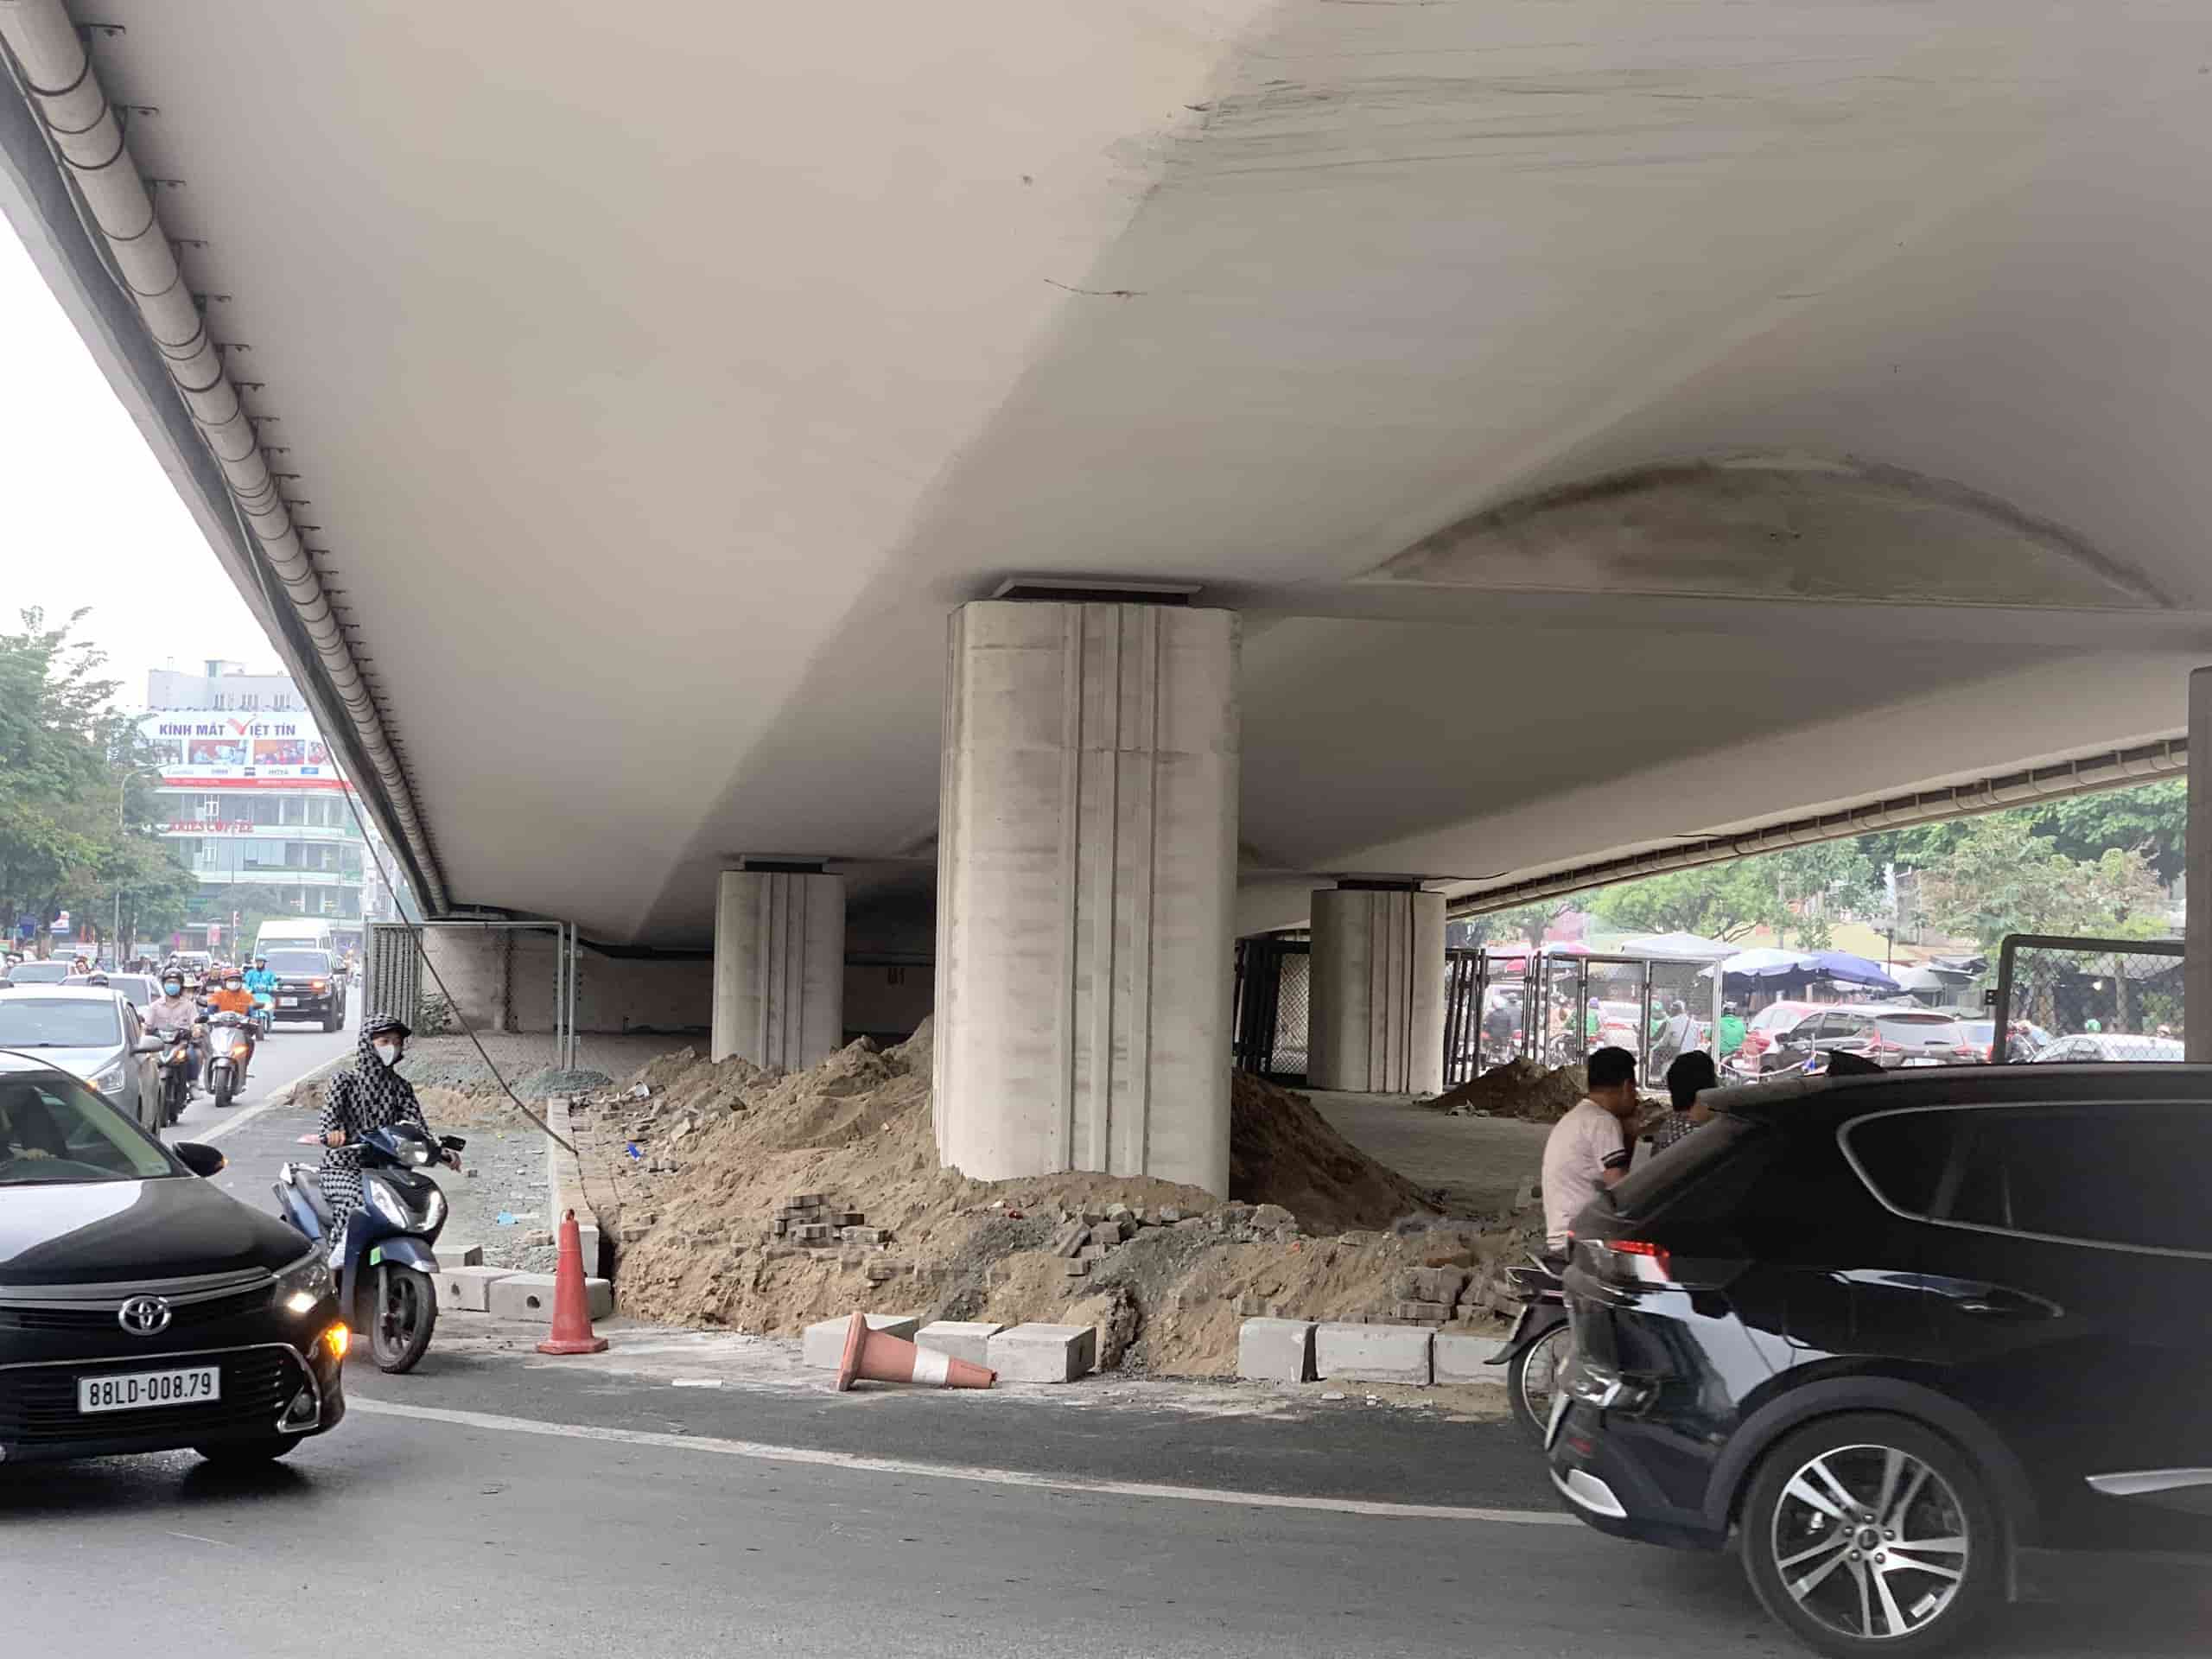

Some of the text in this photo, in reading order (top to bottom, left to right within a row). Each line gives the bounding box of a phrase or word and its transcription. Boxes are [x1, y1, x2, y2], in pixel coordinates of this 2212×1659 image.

[160, 722, 192, 735] KÍNH
[275, 722, 296, 735] TÍN
[89, 1372, 212, 1407] 88LD-008.79
